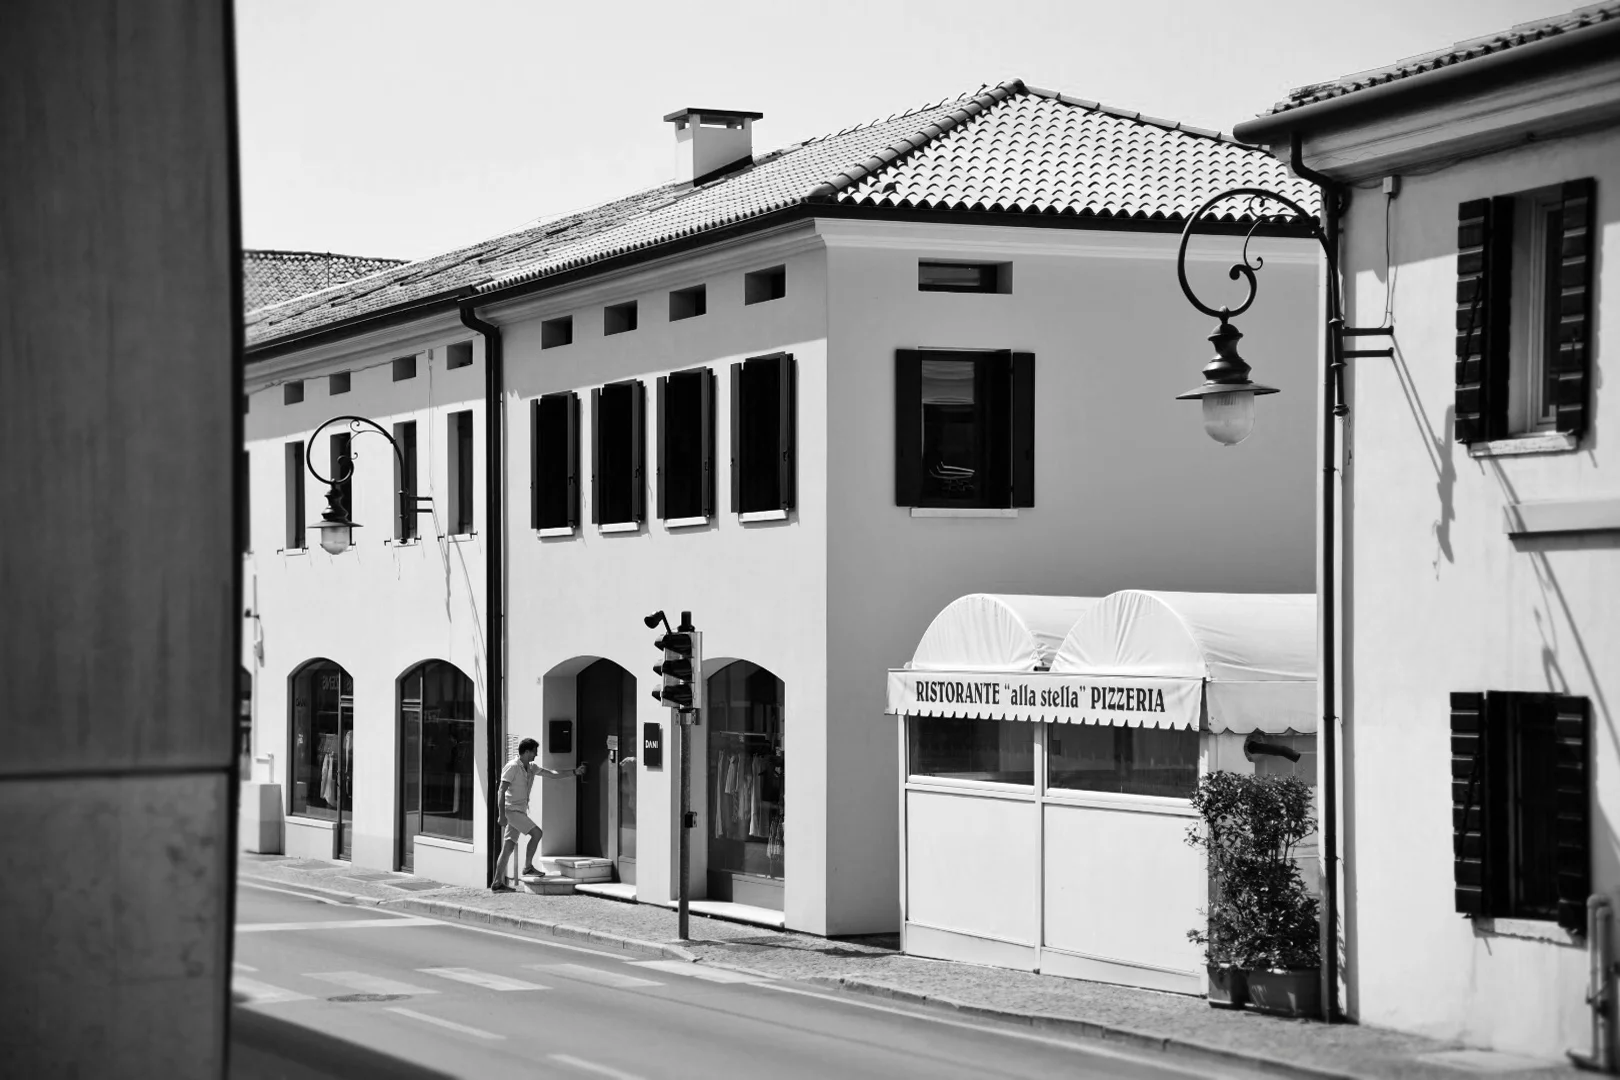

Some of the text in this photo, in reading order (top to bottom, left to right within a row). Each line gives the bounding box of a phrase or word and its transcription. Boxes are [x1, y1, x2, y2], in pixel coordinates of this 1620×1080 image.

[916, 680, 1000, 705] RISTORANTE
[1091, 686, 1166, 713] PIZZERIA
[645, 739, 659, 749] DANI
